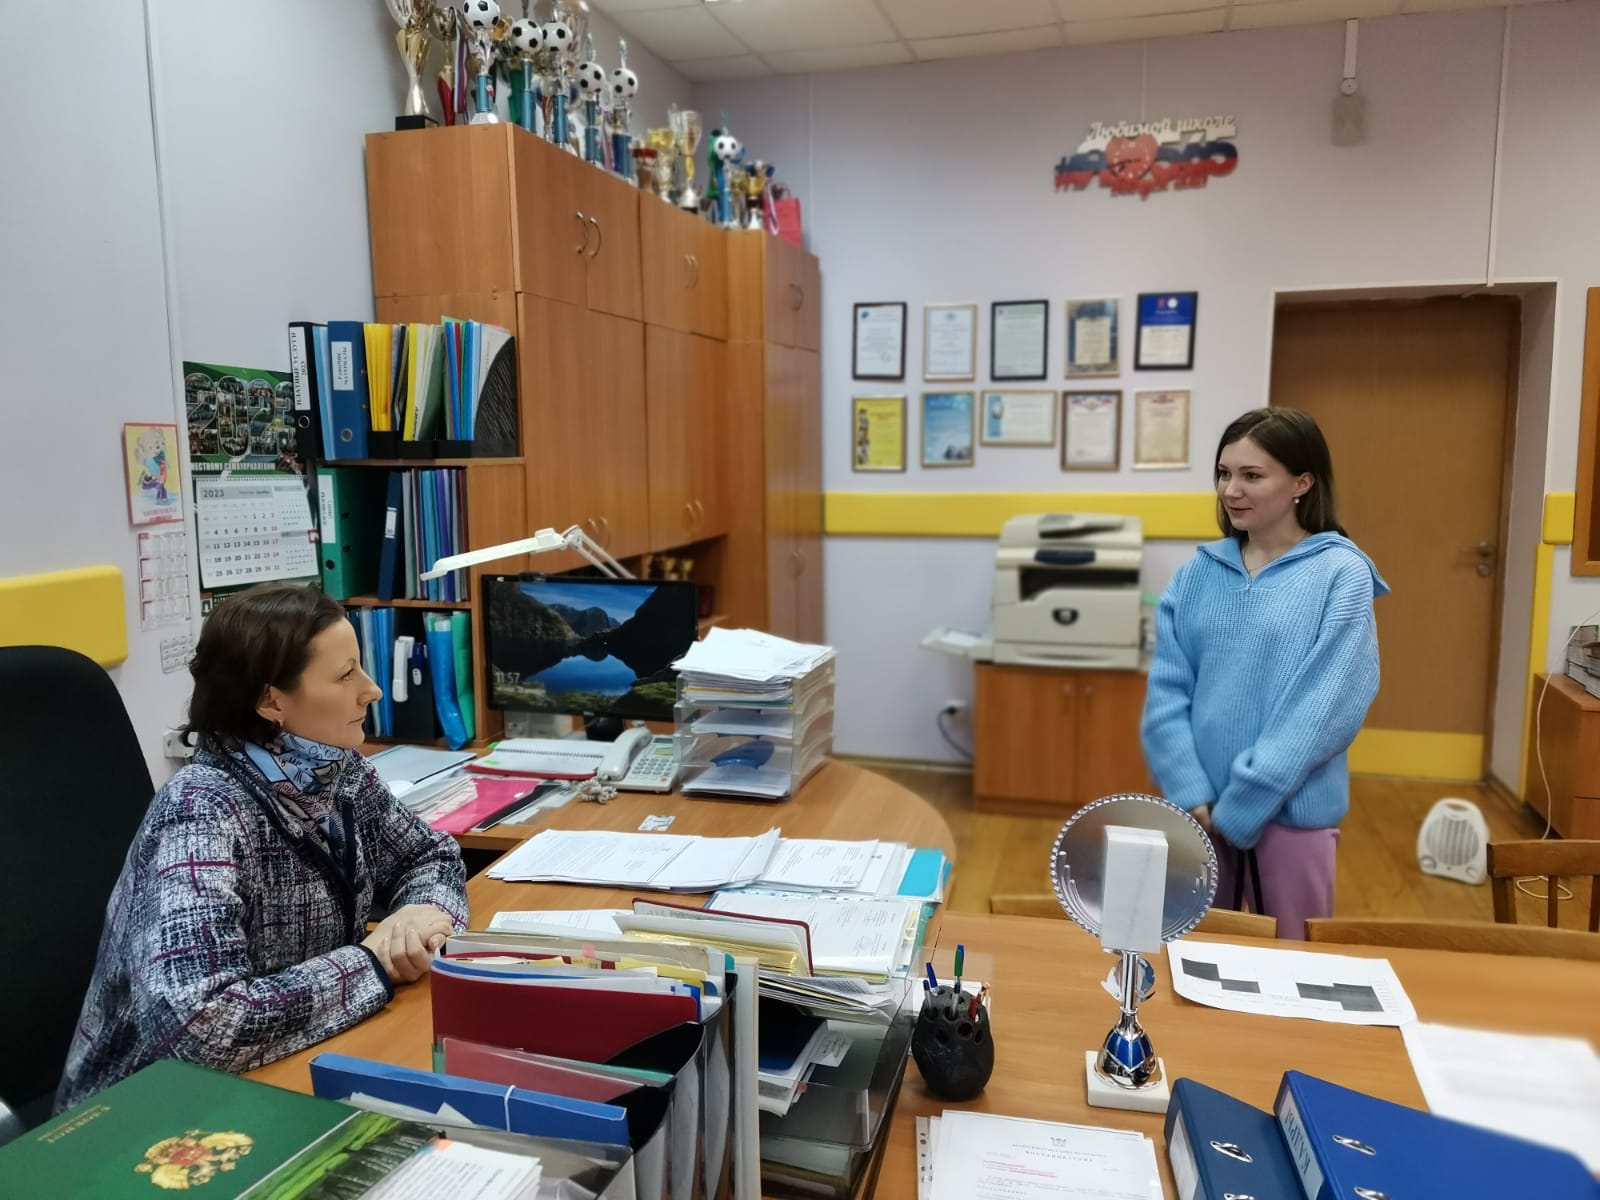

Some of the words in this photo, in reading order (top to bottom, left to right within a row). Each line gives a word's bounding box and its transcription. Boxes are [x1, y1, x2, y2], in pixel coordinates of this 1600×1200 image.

[1087, 117, 1171, 140] Любимой
[1177, 115, 1234, 132] школе
[203, 489, 225, 498] 2023
[1285, 1108, 1311, 1176] КАДРЫ
